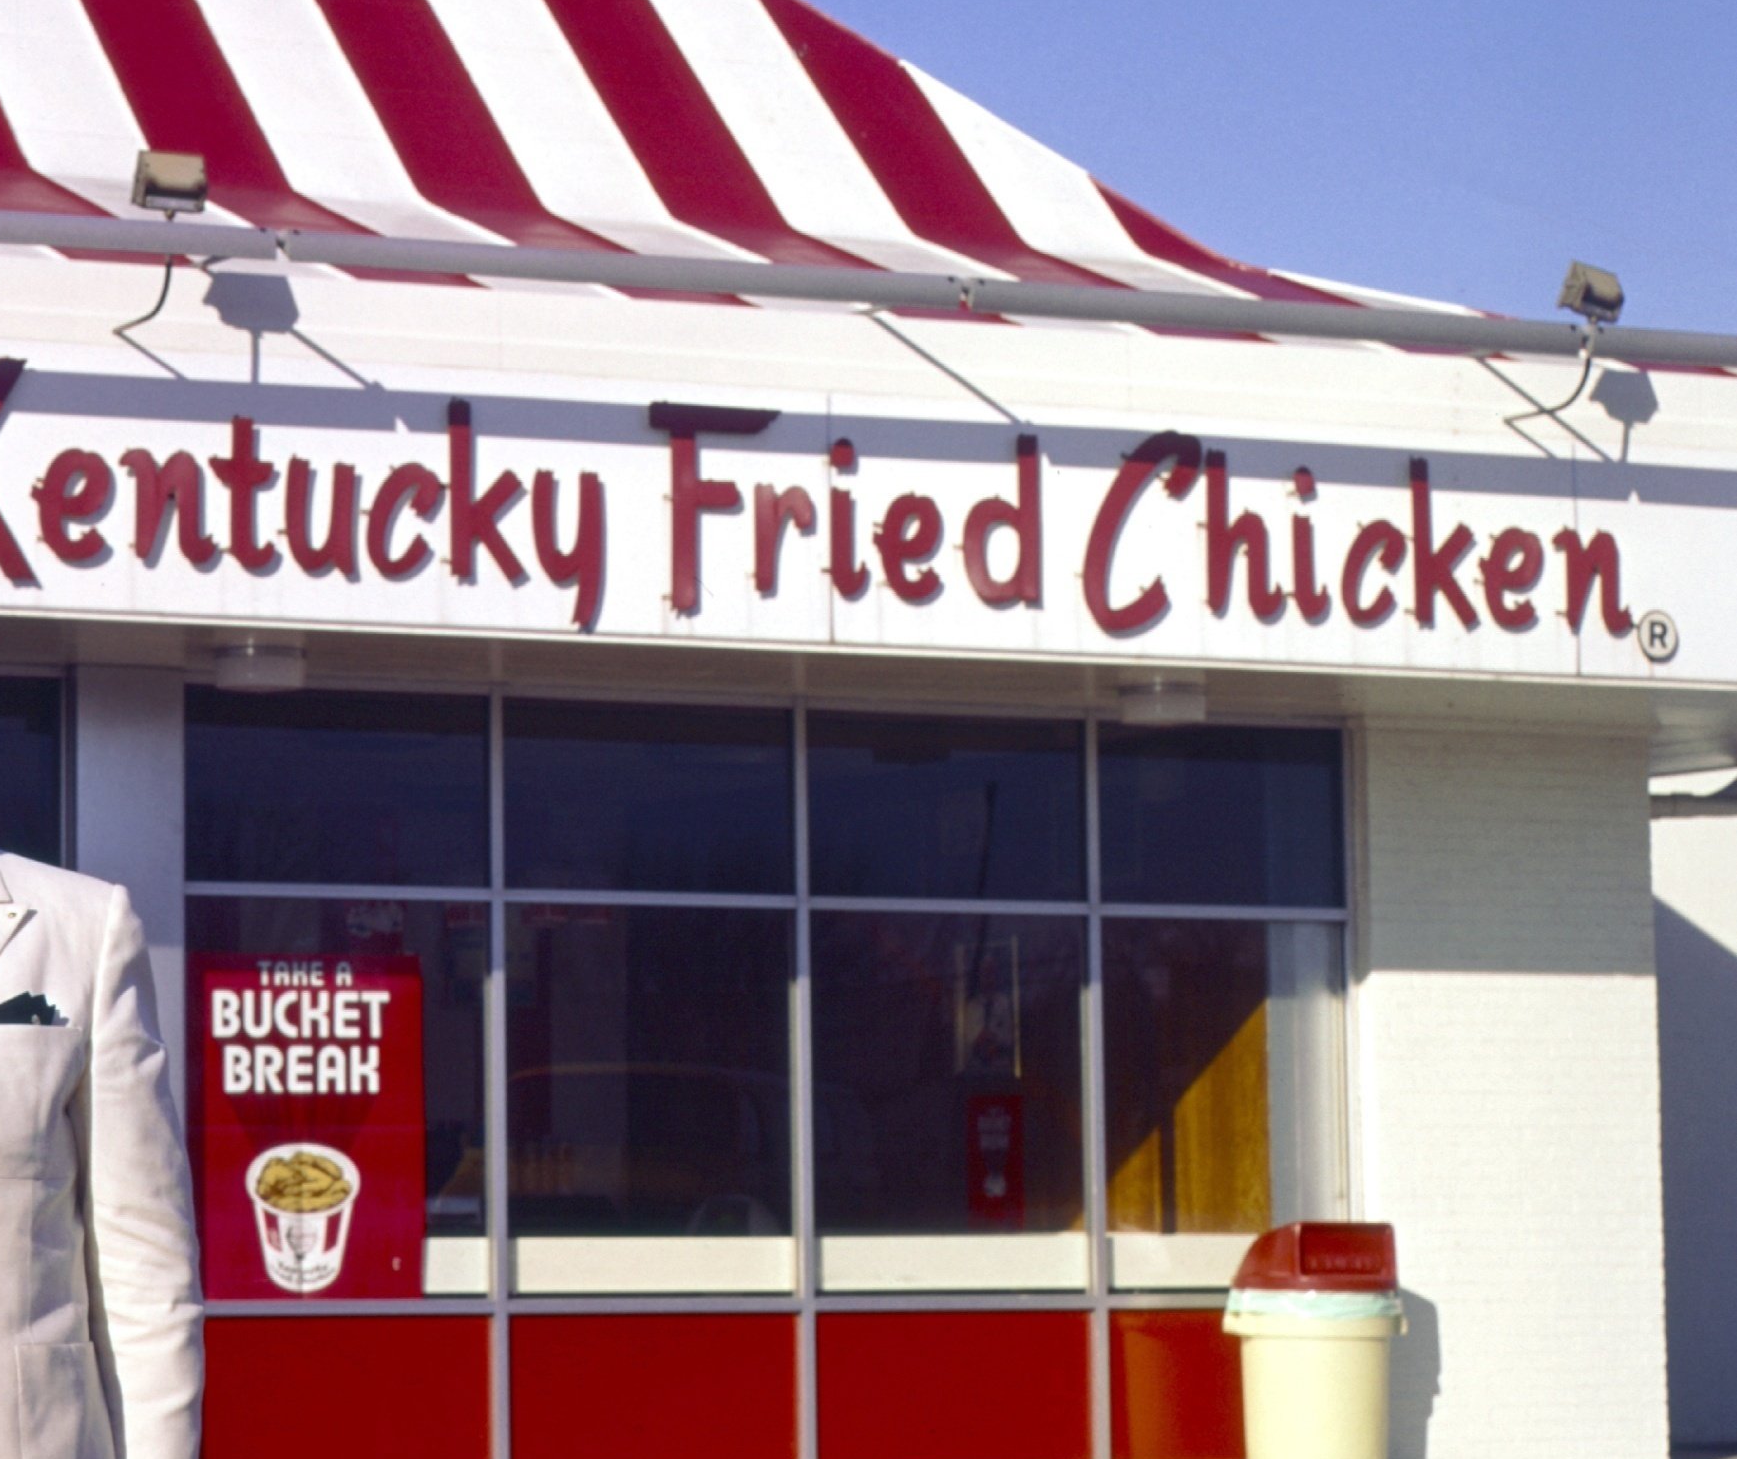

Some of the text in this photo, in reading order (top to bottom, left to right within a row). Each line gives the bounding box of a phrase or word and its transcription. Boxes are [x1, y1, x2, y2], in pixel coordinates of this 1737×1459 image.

[649, 401, 1039, 612] Fried
[1083, 430, 1633, 637] Chicken
[258, 961, 353, 987] TAKE A
[212, 989, 390, 1039] BUCKET
[223, 1044, 380, 1094] BREAK
